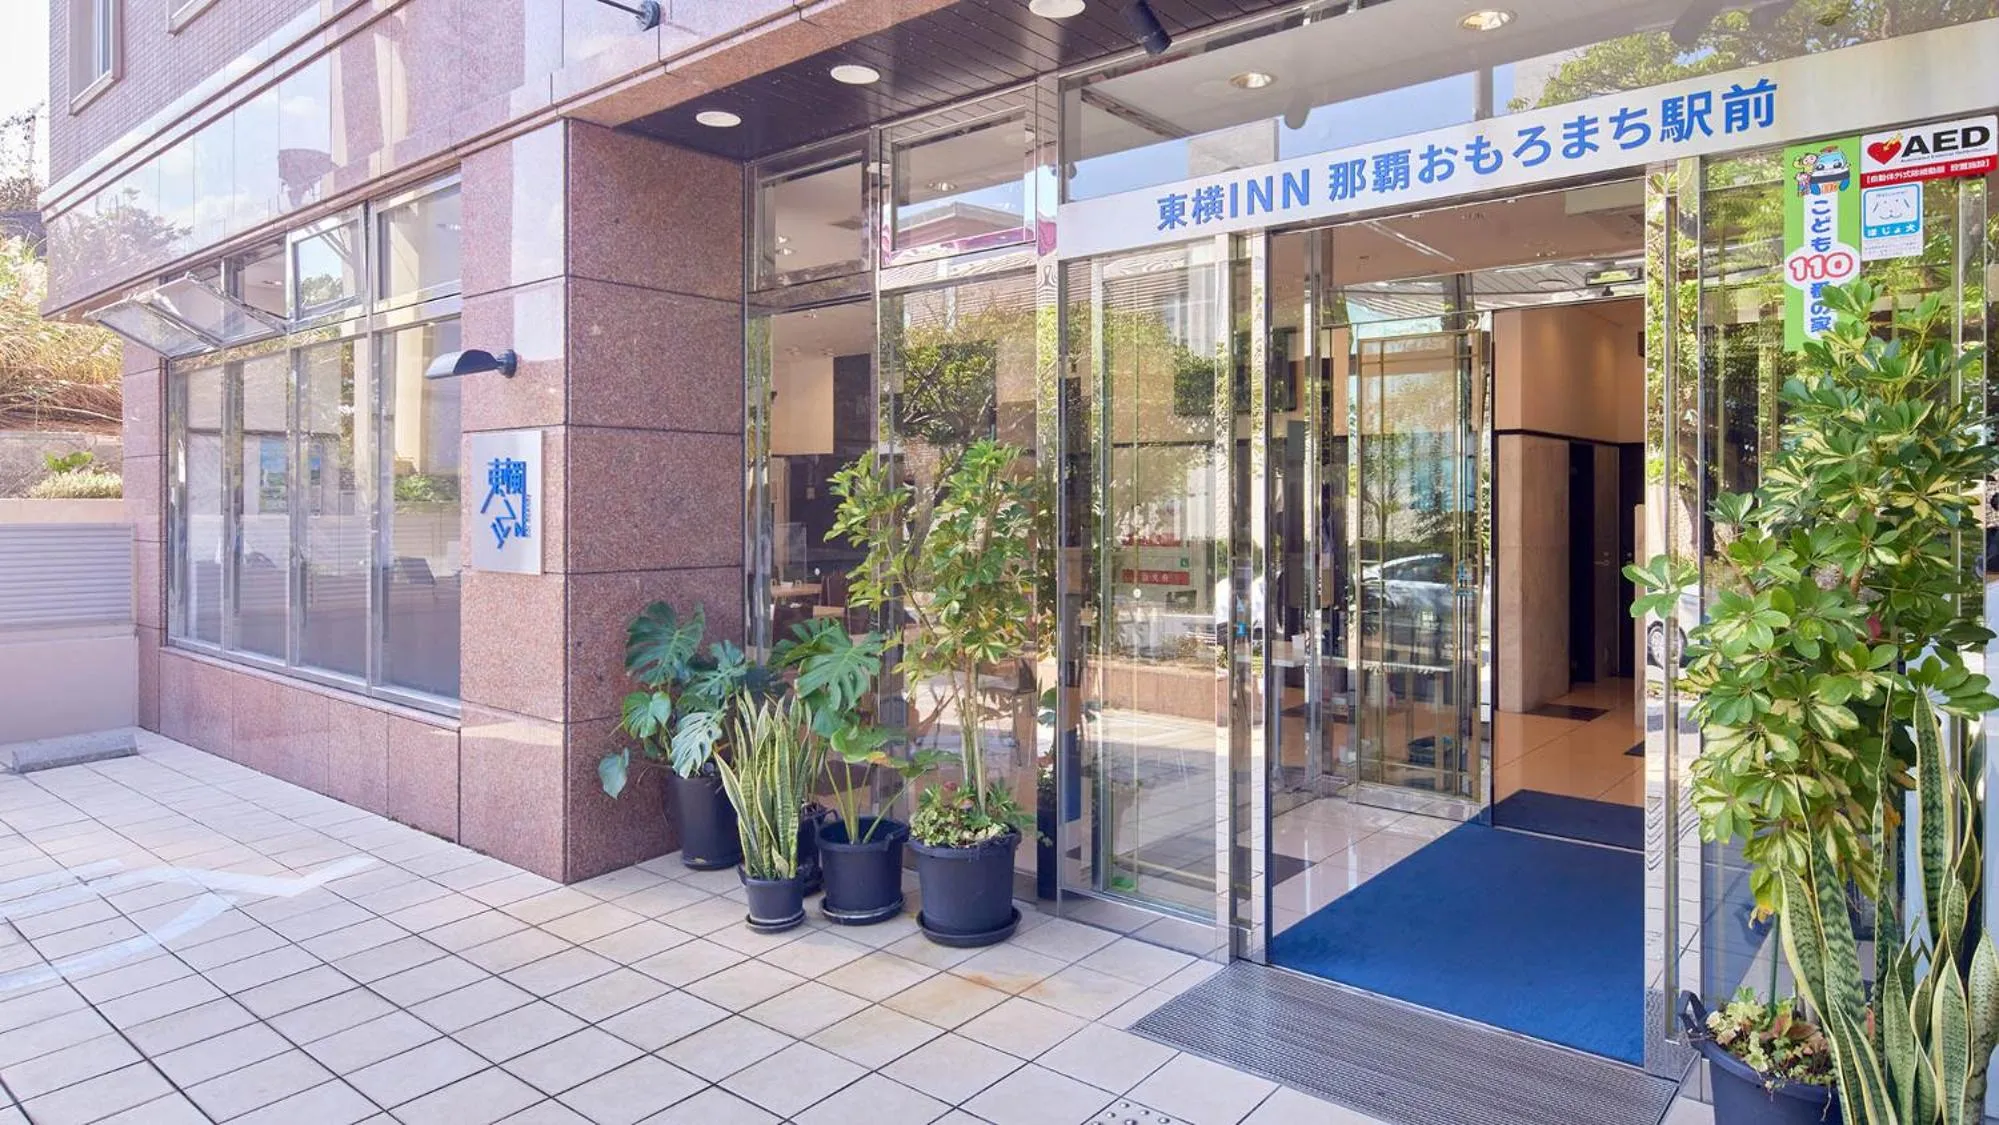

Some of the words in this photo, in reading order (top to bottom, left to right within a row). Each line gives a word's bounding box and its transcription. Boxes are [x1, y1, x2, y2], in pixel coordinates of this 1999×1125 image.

[1156, 168, 1310, 231] 東横INN
[1328, 78, 1778, 202] 那覇おもろまち駅前
[1901, 126, 1990, 158] AED
[1789, 251, 1854, 282] 110
